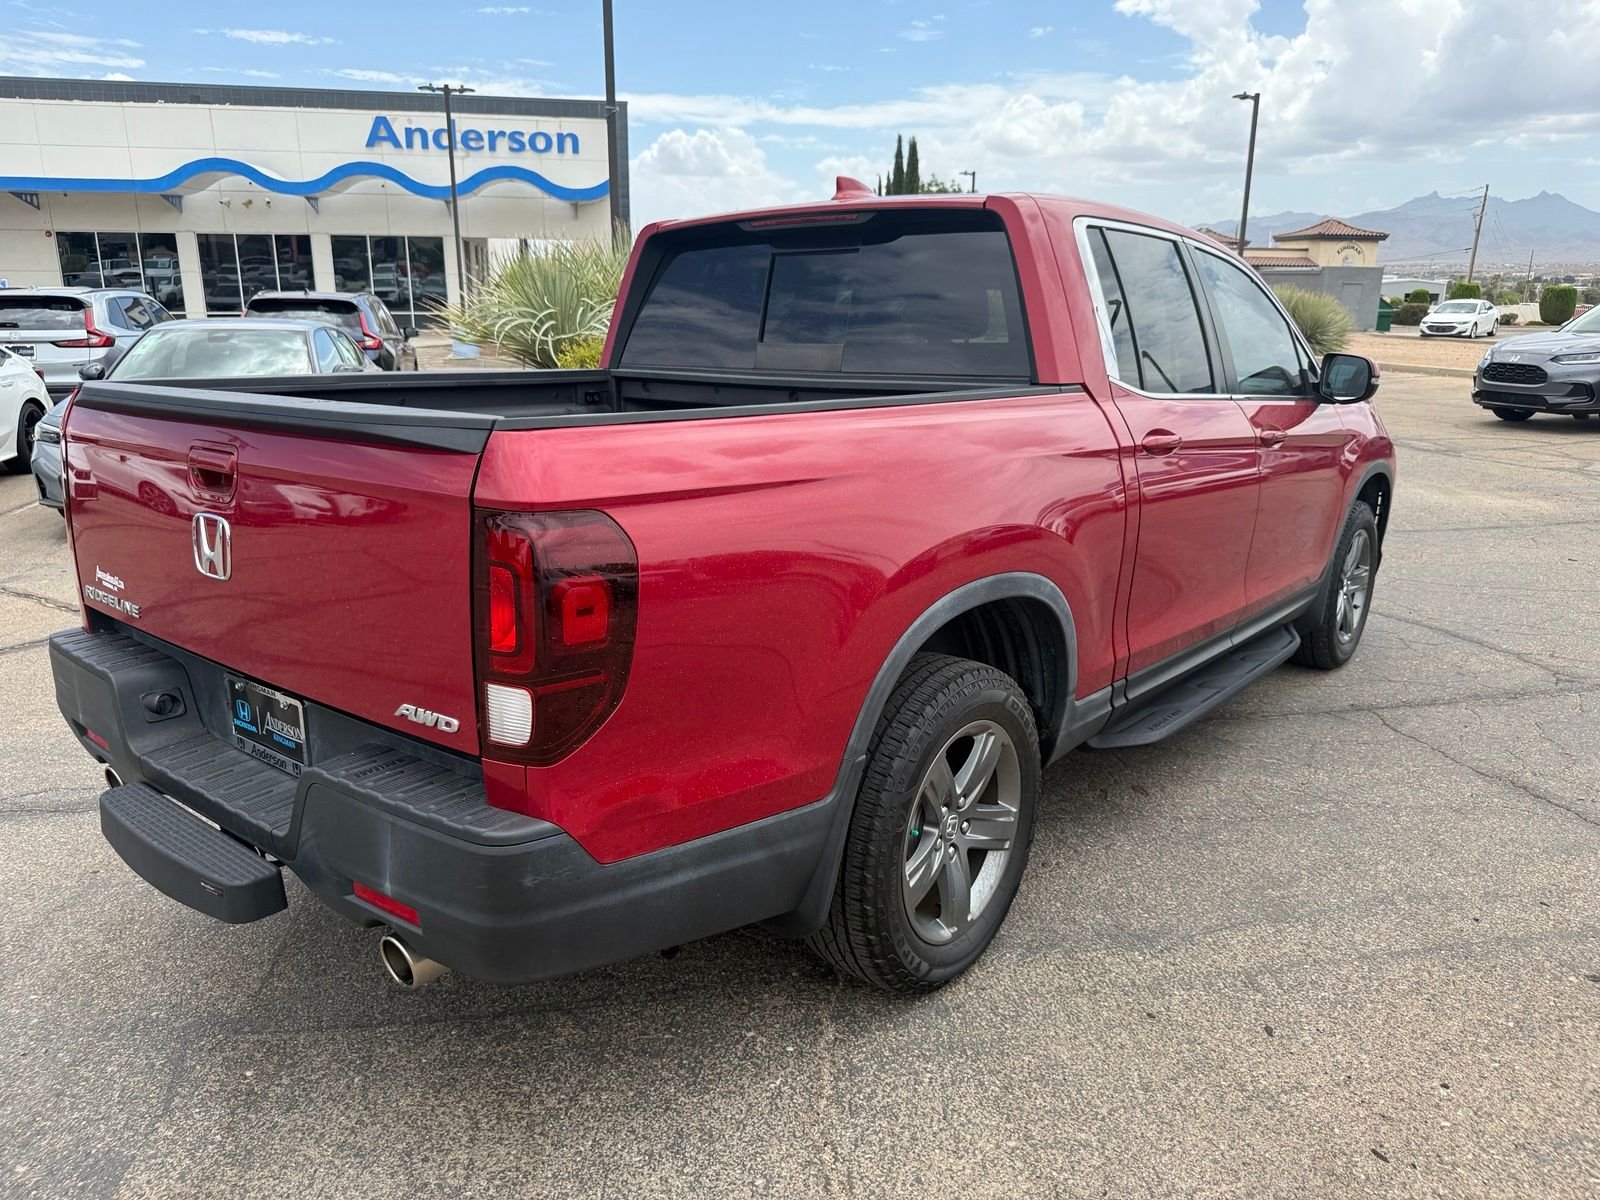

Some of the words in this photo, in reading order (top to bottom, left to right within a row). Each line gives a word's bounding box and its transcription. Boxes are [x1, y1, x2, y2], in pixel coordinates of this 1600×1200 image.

[365, 115, 580, 155] Anderson
[85, 584, 142, 619] RIDGELINE
[233, 718, 258, 734] HONDA
[262, 711, 304, 740] ANDERSON
[393, 703, 459, 734] AWD
[273, 732, 296, 750] KINGMAN
[251, 743, 287, 770] Anderson
